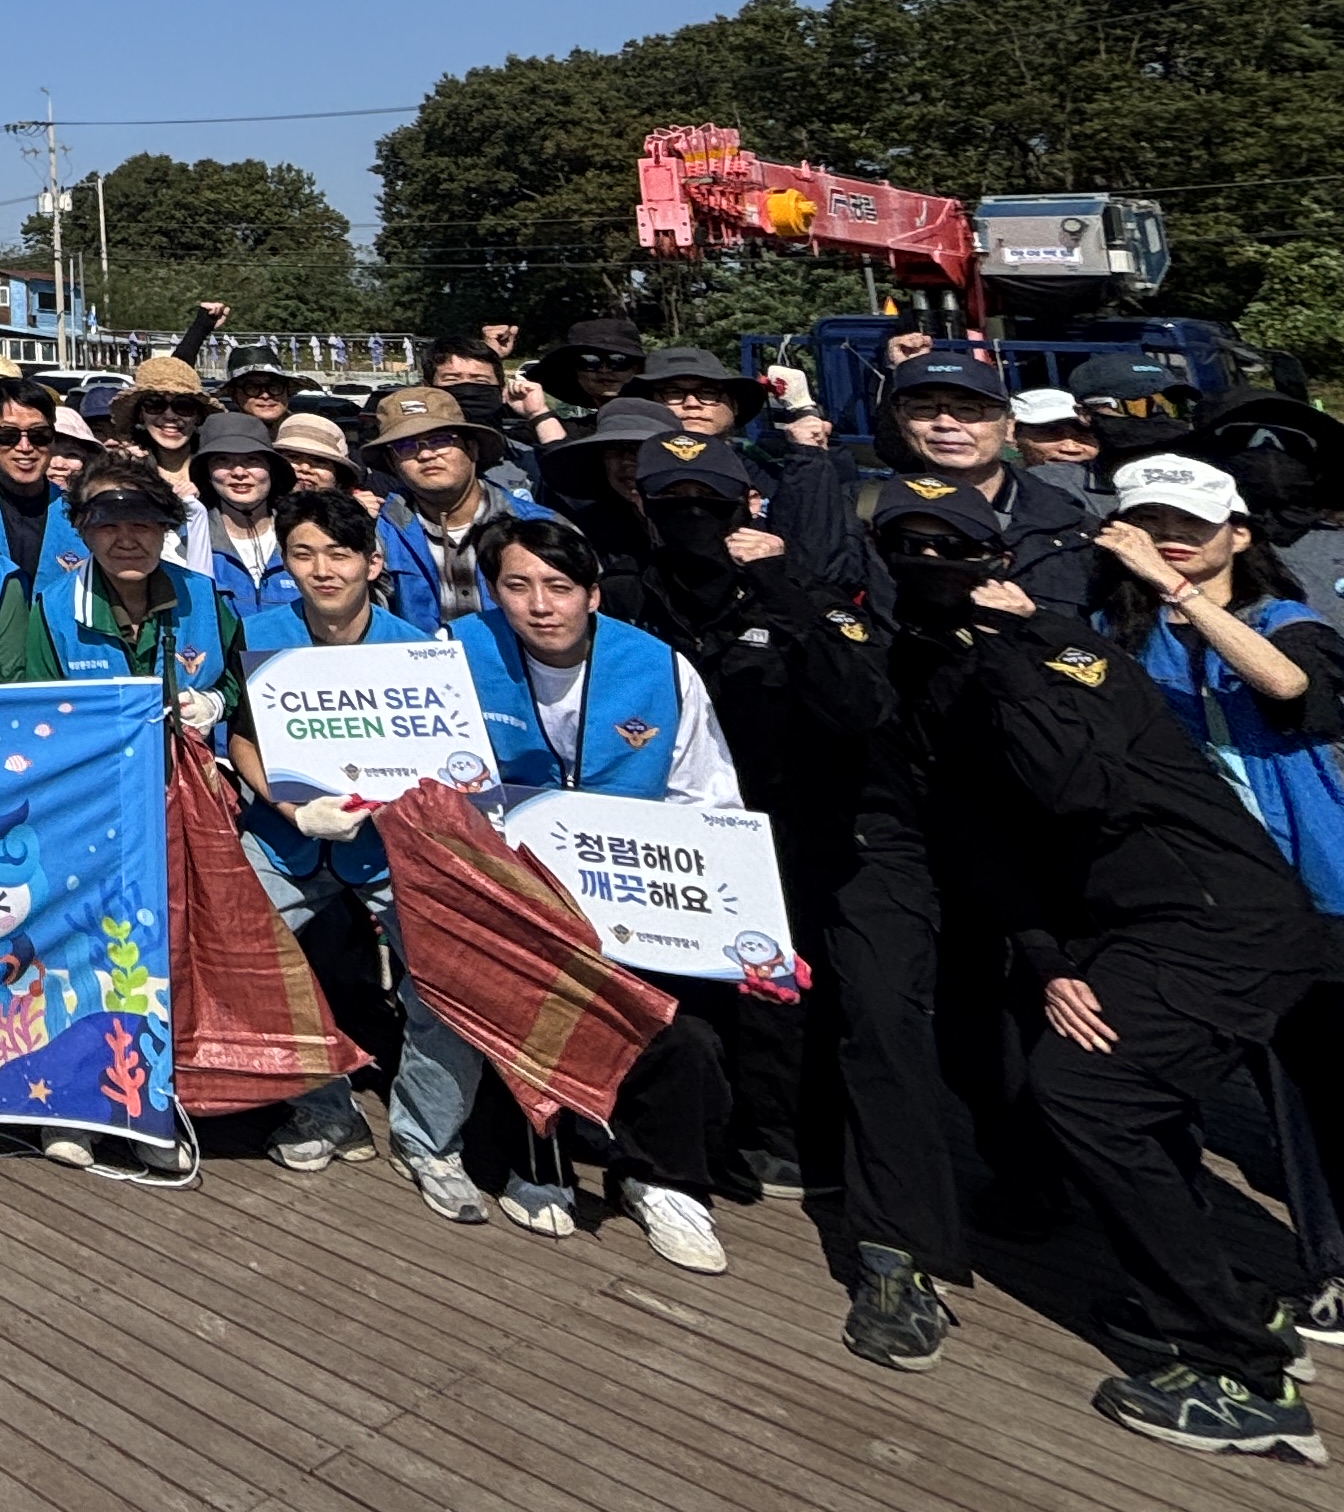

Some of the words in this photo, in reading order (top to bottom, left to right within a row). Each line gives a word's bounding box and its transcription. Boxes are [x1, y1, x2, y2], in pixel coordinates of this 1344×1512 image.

[280, 689, 378, 713] CLEAN
[384, 687, 445, 710] SEA
[286, 716, 386, 740] GREEN
[391, 715, 453, 737] SEA
[574, 832, 706, 876] 청렴해야
[578, 869, 712, 914] 깨끗해요
